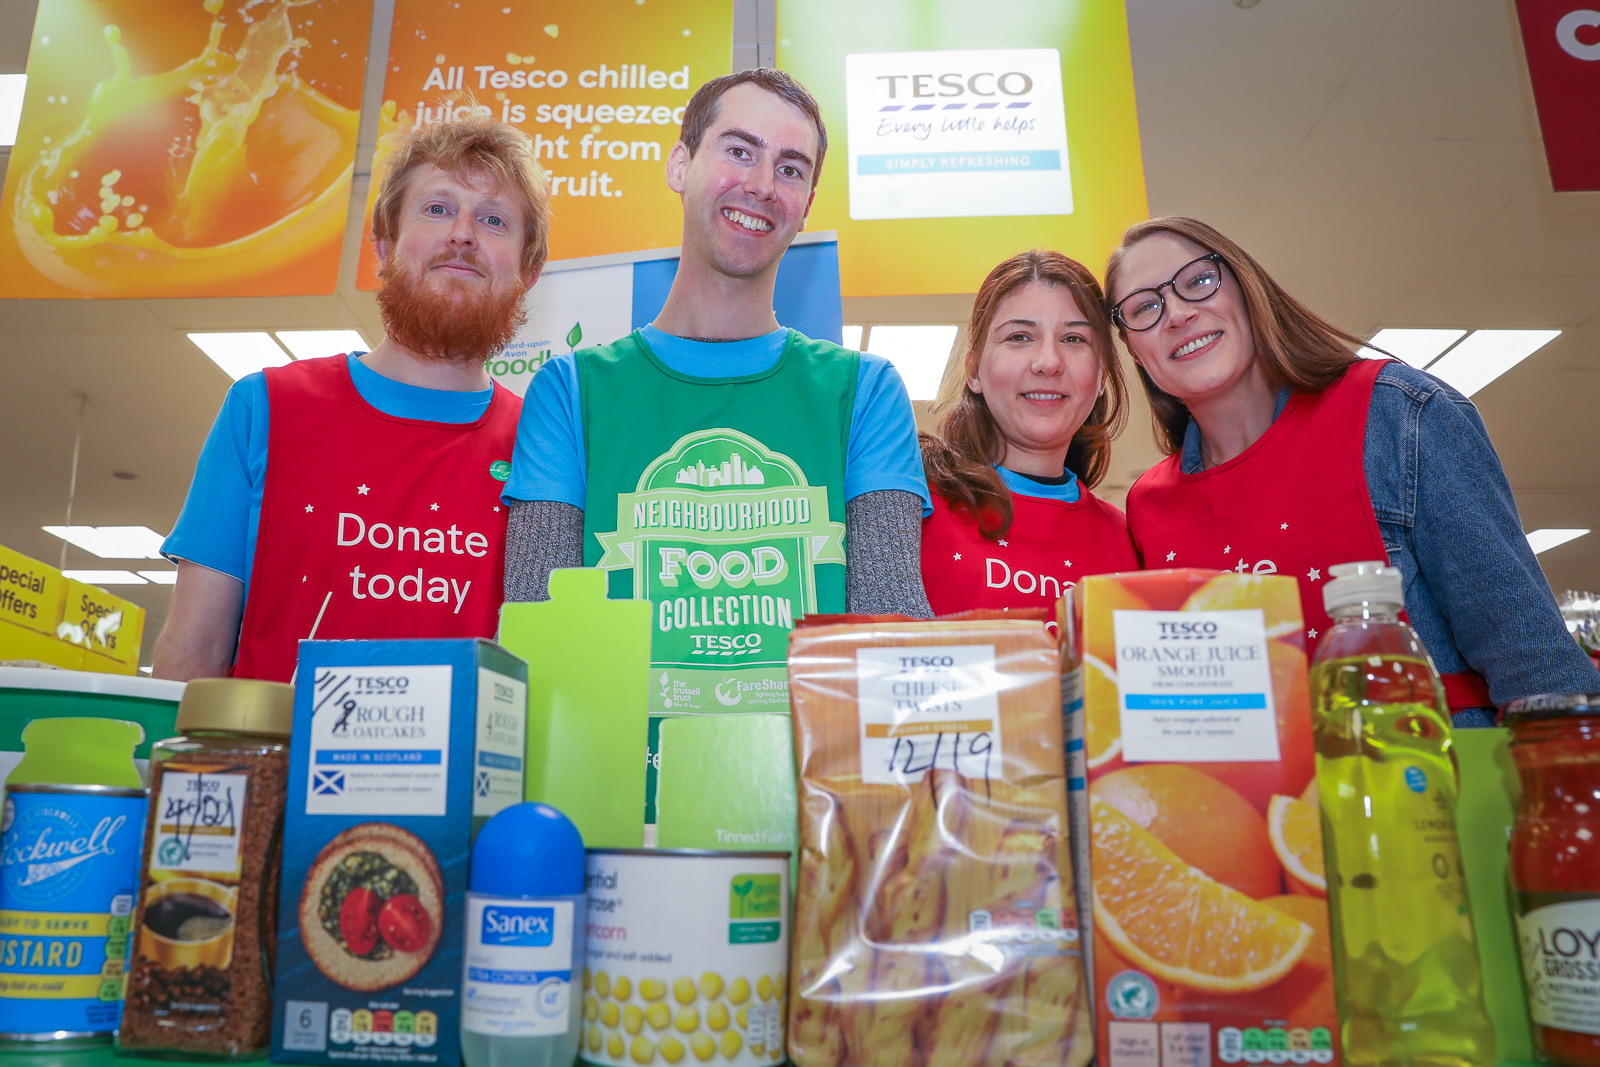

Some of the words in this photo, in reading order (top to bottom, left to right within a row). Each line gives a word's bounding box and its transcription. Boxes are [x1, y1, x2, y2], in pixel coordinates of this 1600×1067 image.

[422, 66, 464, 91] All
[474, 66, 569, 89] Tesco
[578, 64, 689, 89] chilled
[876, 71, 1033, 98] TESCO
[501, 98, 526, 123] is
[876, 117, 932, 140] Every
[940, 116, 986, 132] little
[992, 115, 1036, 136] helps
[580, 133, 661, 161] from
[886, 157, 936, 170] SIMPLY
[940, 155, 1031, 168] REFRESHING
[504, 350, 527, 358] Avon
[633, 497, 811, 532] NEIGHBOURHOOD
[337, 512, 489, 557] Donate
[659, 546, 787, 588] FOOD
[0, 565, 46, 595] pecial
[985, 557, 1077, 598] Dona
[349, 565, 471, 614] today
[659, 595, 793, 632] COLLECTION
[1158, 621, 1218, 634] TESCO
[690, 633, 762, 650] TESCO
[899, 655, 954, 667] TESCO
[1121, 645, 1202, 662] ORANGE
[1205, 644, 1261, 662] JUICE
[1157, 665, 1226, 678] SMOOTH
[355, 676, 409, 689] TESCO
[673, 679, 687, 688] the
[673, 687, 701, 696] trussell
[673, 693, 692, 702] trust
[755, 691, 776, 699] fighting
[776, 691, 790, 699] hung
[356, 705, 426, 723] ROUGH
[352, 726, 426, 739] OATCAKES
[373, 753, 423, 761] SCOTLAND
[715, 829, 760, 844] Tinned
[23, 918, 40, 929] TO
[45, 919, 90, 931] SERVE
[485, 909, 549, 935] Sanex
[1538, 927, 1600, 959] LOY
[299, 1008, 313, 1029] 6
